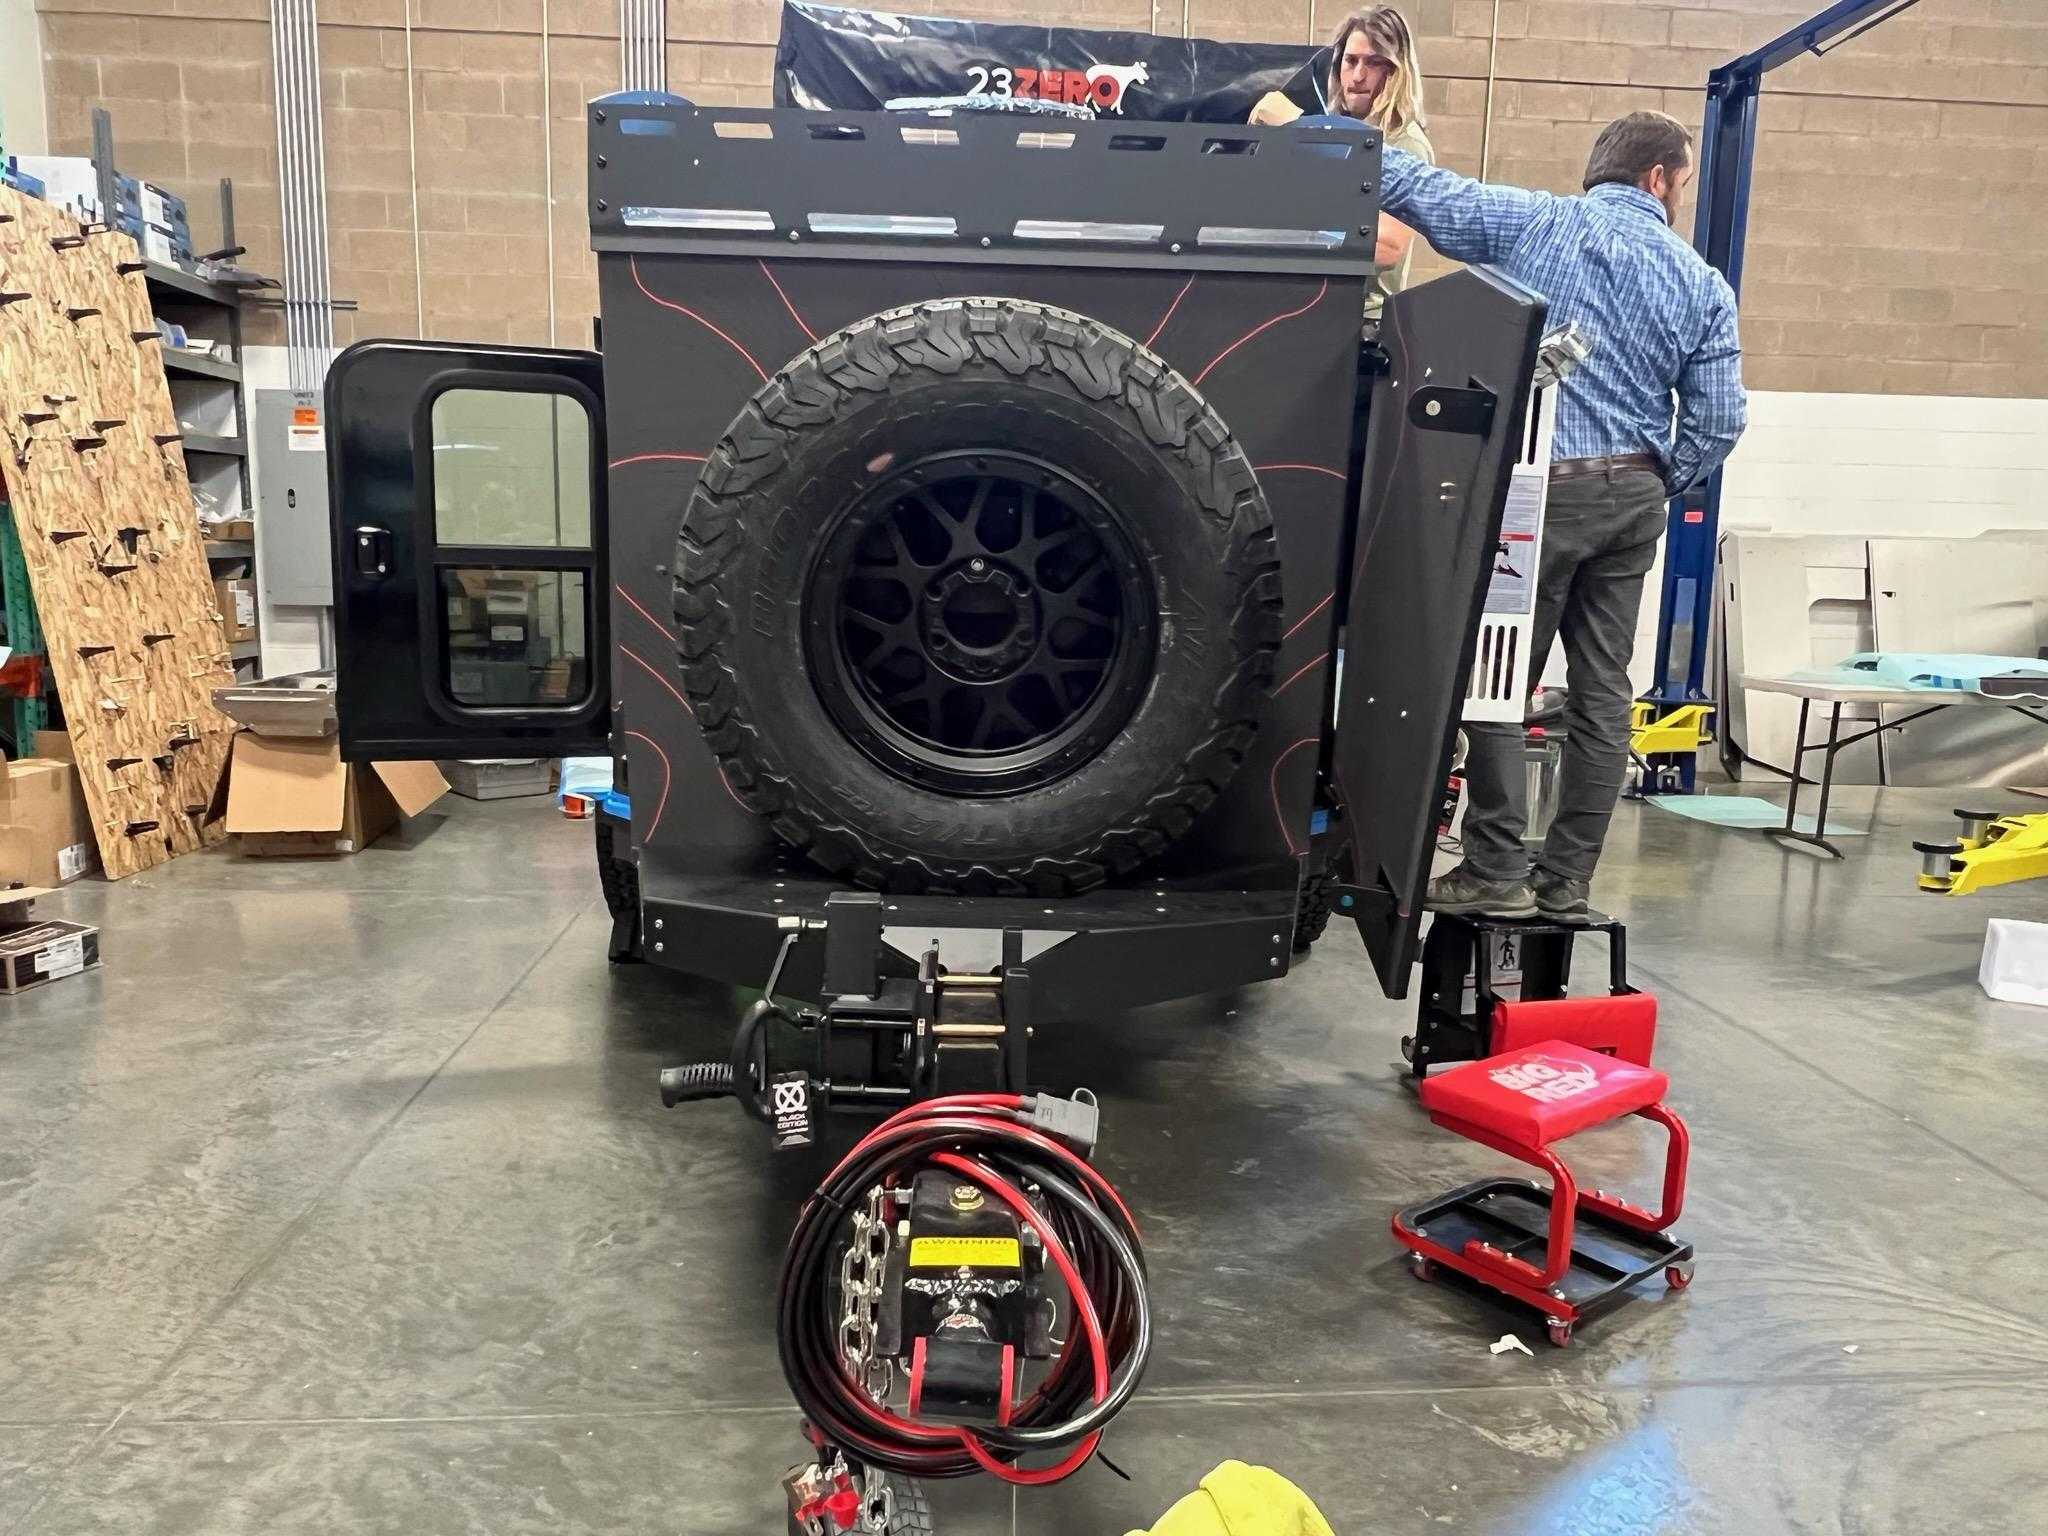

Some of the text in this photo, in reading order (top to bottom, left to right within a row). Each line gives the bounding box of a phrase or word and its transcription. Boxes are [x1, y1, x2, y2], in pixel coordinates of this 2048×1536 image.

[966, 66, 1120, 107] 23ZERO
[1490, 1063, 1563, 1090] BIG
[1520, 1073, 1599, 1103] RED
[777, 1120, 808, 1129] EDITION
[778, 1113, 805, 1121] BLACK
